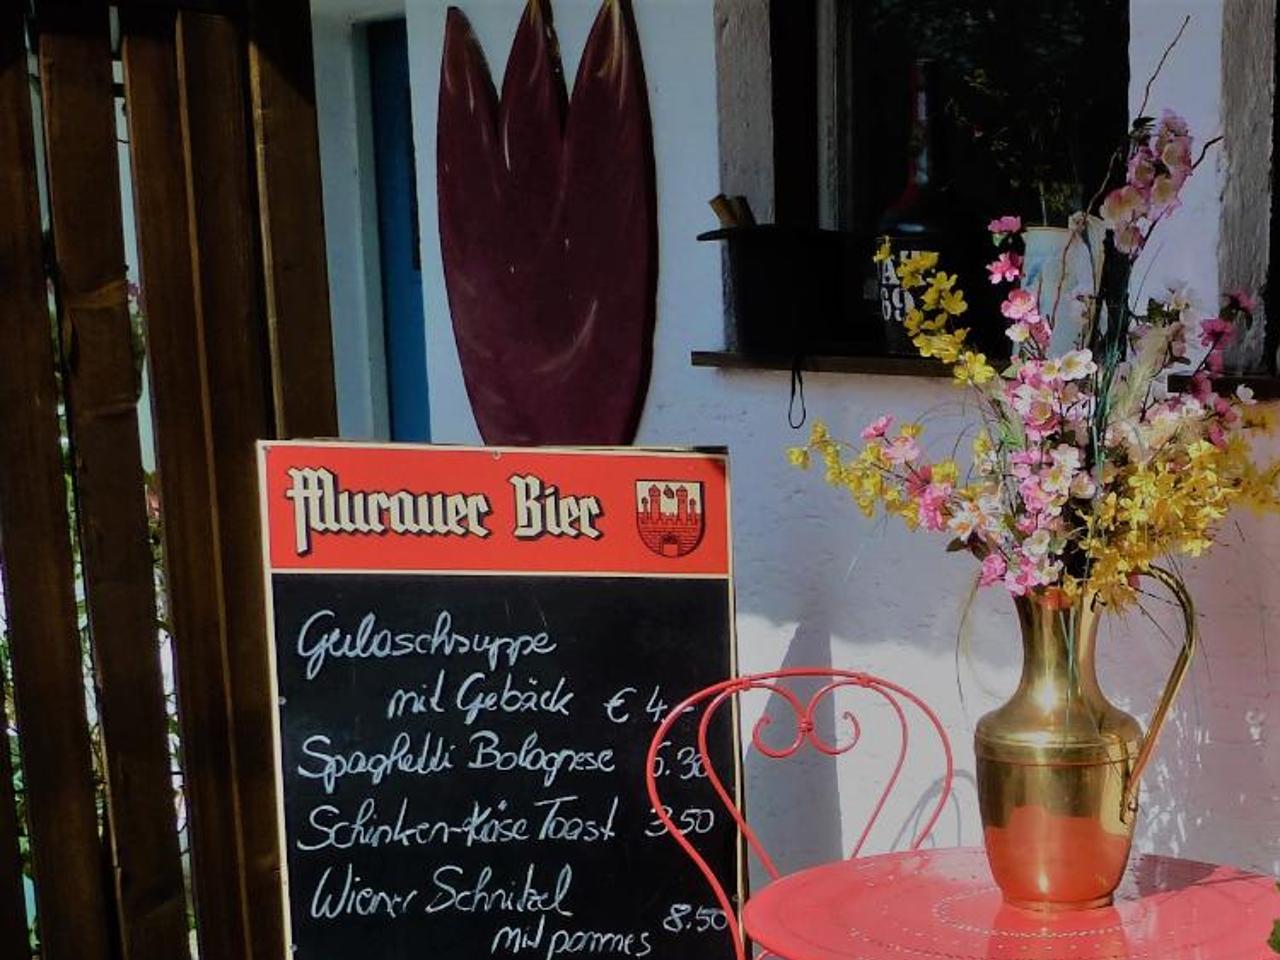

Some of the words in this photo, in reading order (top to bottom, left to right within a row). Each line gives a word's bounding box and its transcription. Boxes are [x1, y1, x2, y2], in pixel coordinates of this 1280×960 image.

[286, 465, 494, 556] Murauer
[508, 473, 607, 542] Bier
[298, 609, 557, 680] Gulaschsuppe
[386, 669, 445, 719] mit
[456, 671, 576, 725] Gebäck
[603, 686, 638, 724] €
[297, 732, 457, 796] Spaghetti
[469, 730, 616, 786] Bolognese
[534, 795, 617, 842] Toast
[311, 863, 418, 918] Wiener
[491, 913, 545, 954] mit
[663, 903, 727, 932] 8.50
